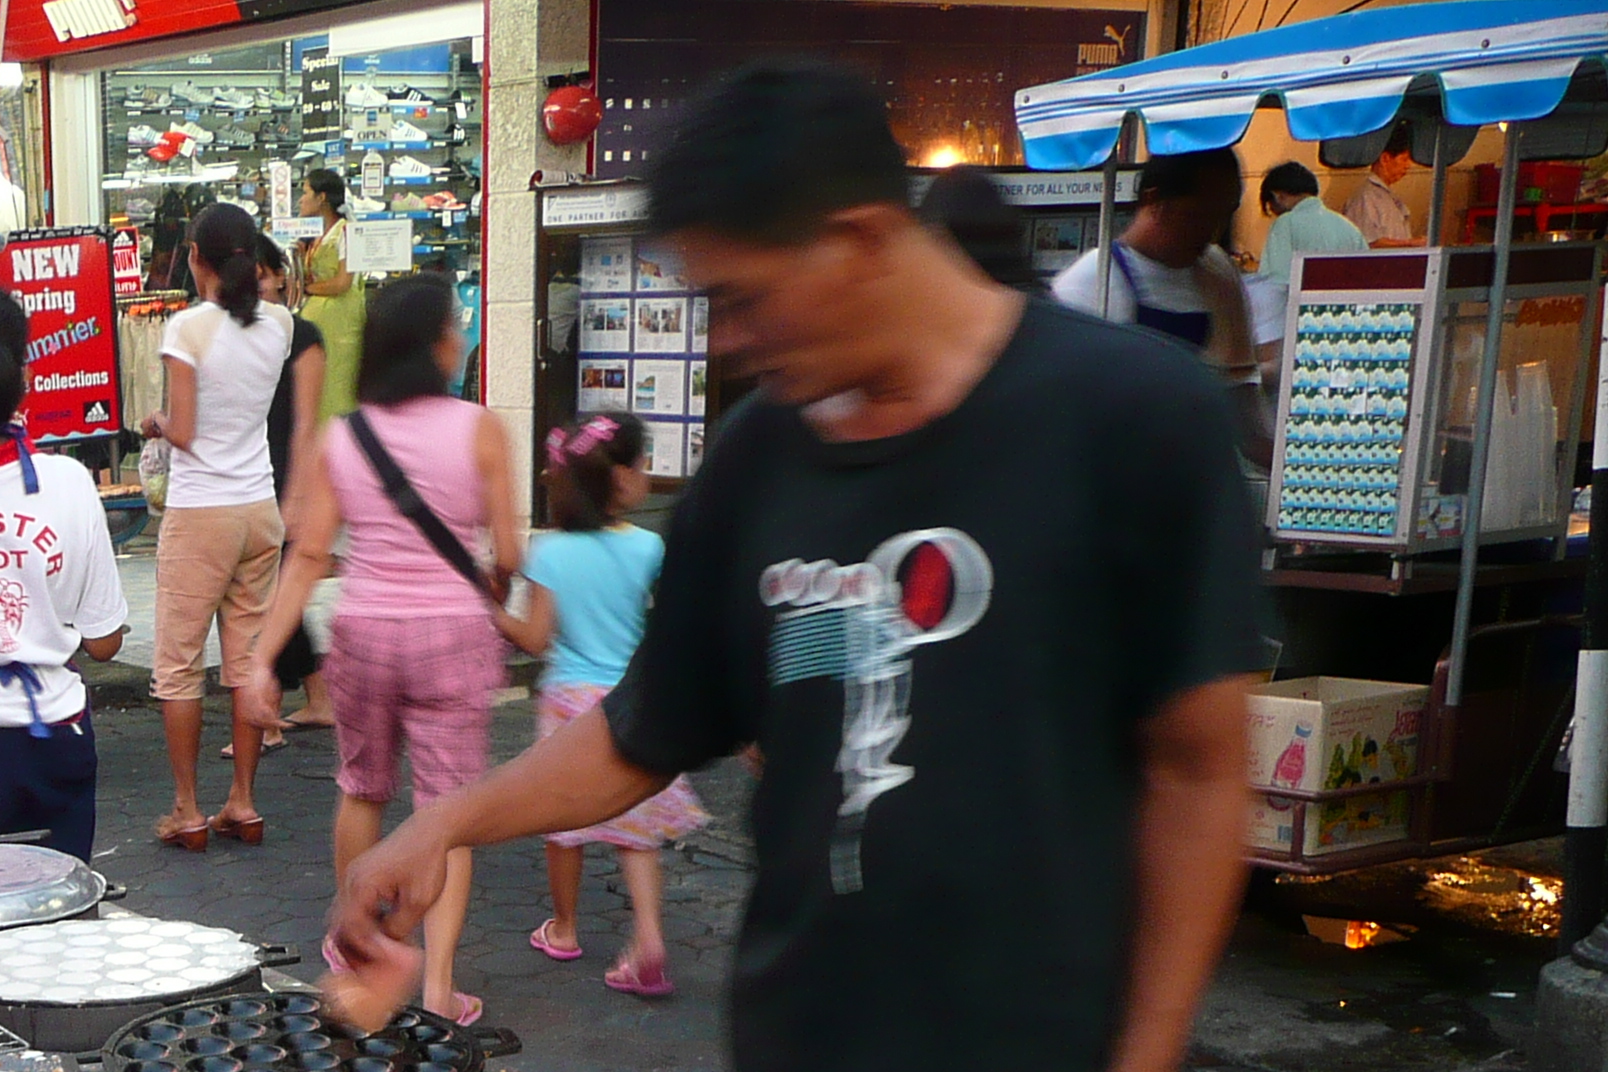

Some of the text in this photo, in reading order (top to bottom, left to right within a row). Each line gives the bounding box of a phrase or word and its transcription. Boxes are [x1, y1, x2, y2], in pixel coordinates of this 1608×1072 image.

[1077, 44, 1118, 65] PUMA
[357, 131, 388, 140] OPEN
[1025, 184, 1045, 195] FOR
[1046, 183, 1063, 194] ALL
[1065, 182, 1091, 194] YOUR
[1092, 182, 1123, 193] NES
[568, 211, 604, 221] PARTNER
[11, 244, 80, 282] NEW
[24, 317, 101, 362] ummer
[34, 370, 109, 392] Collections
